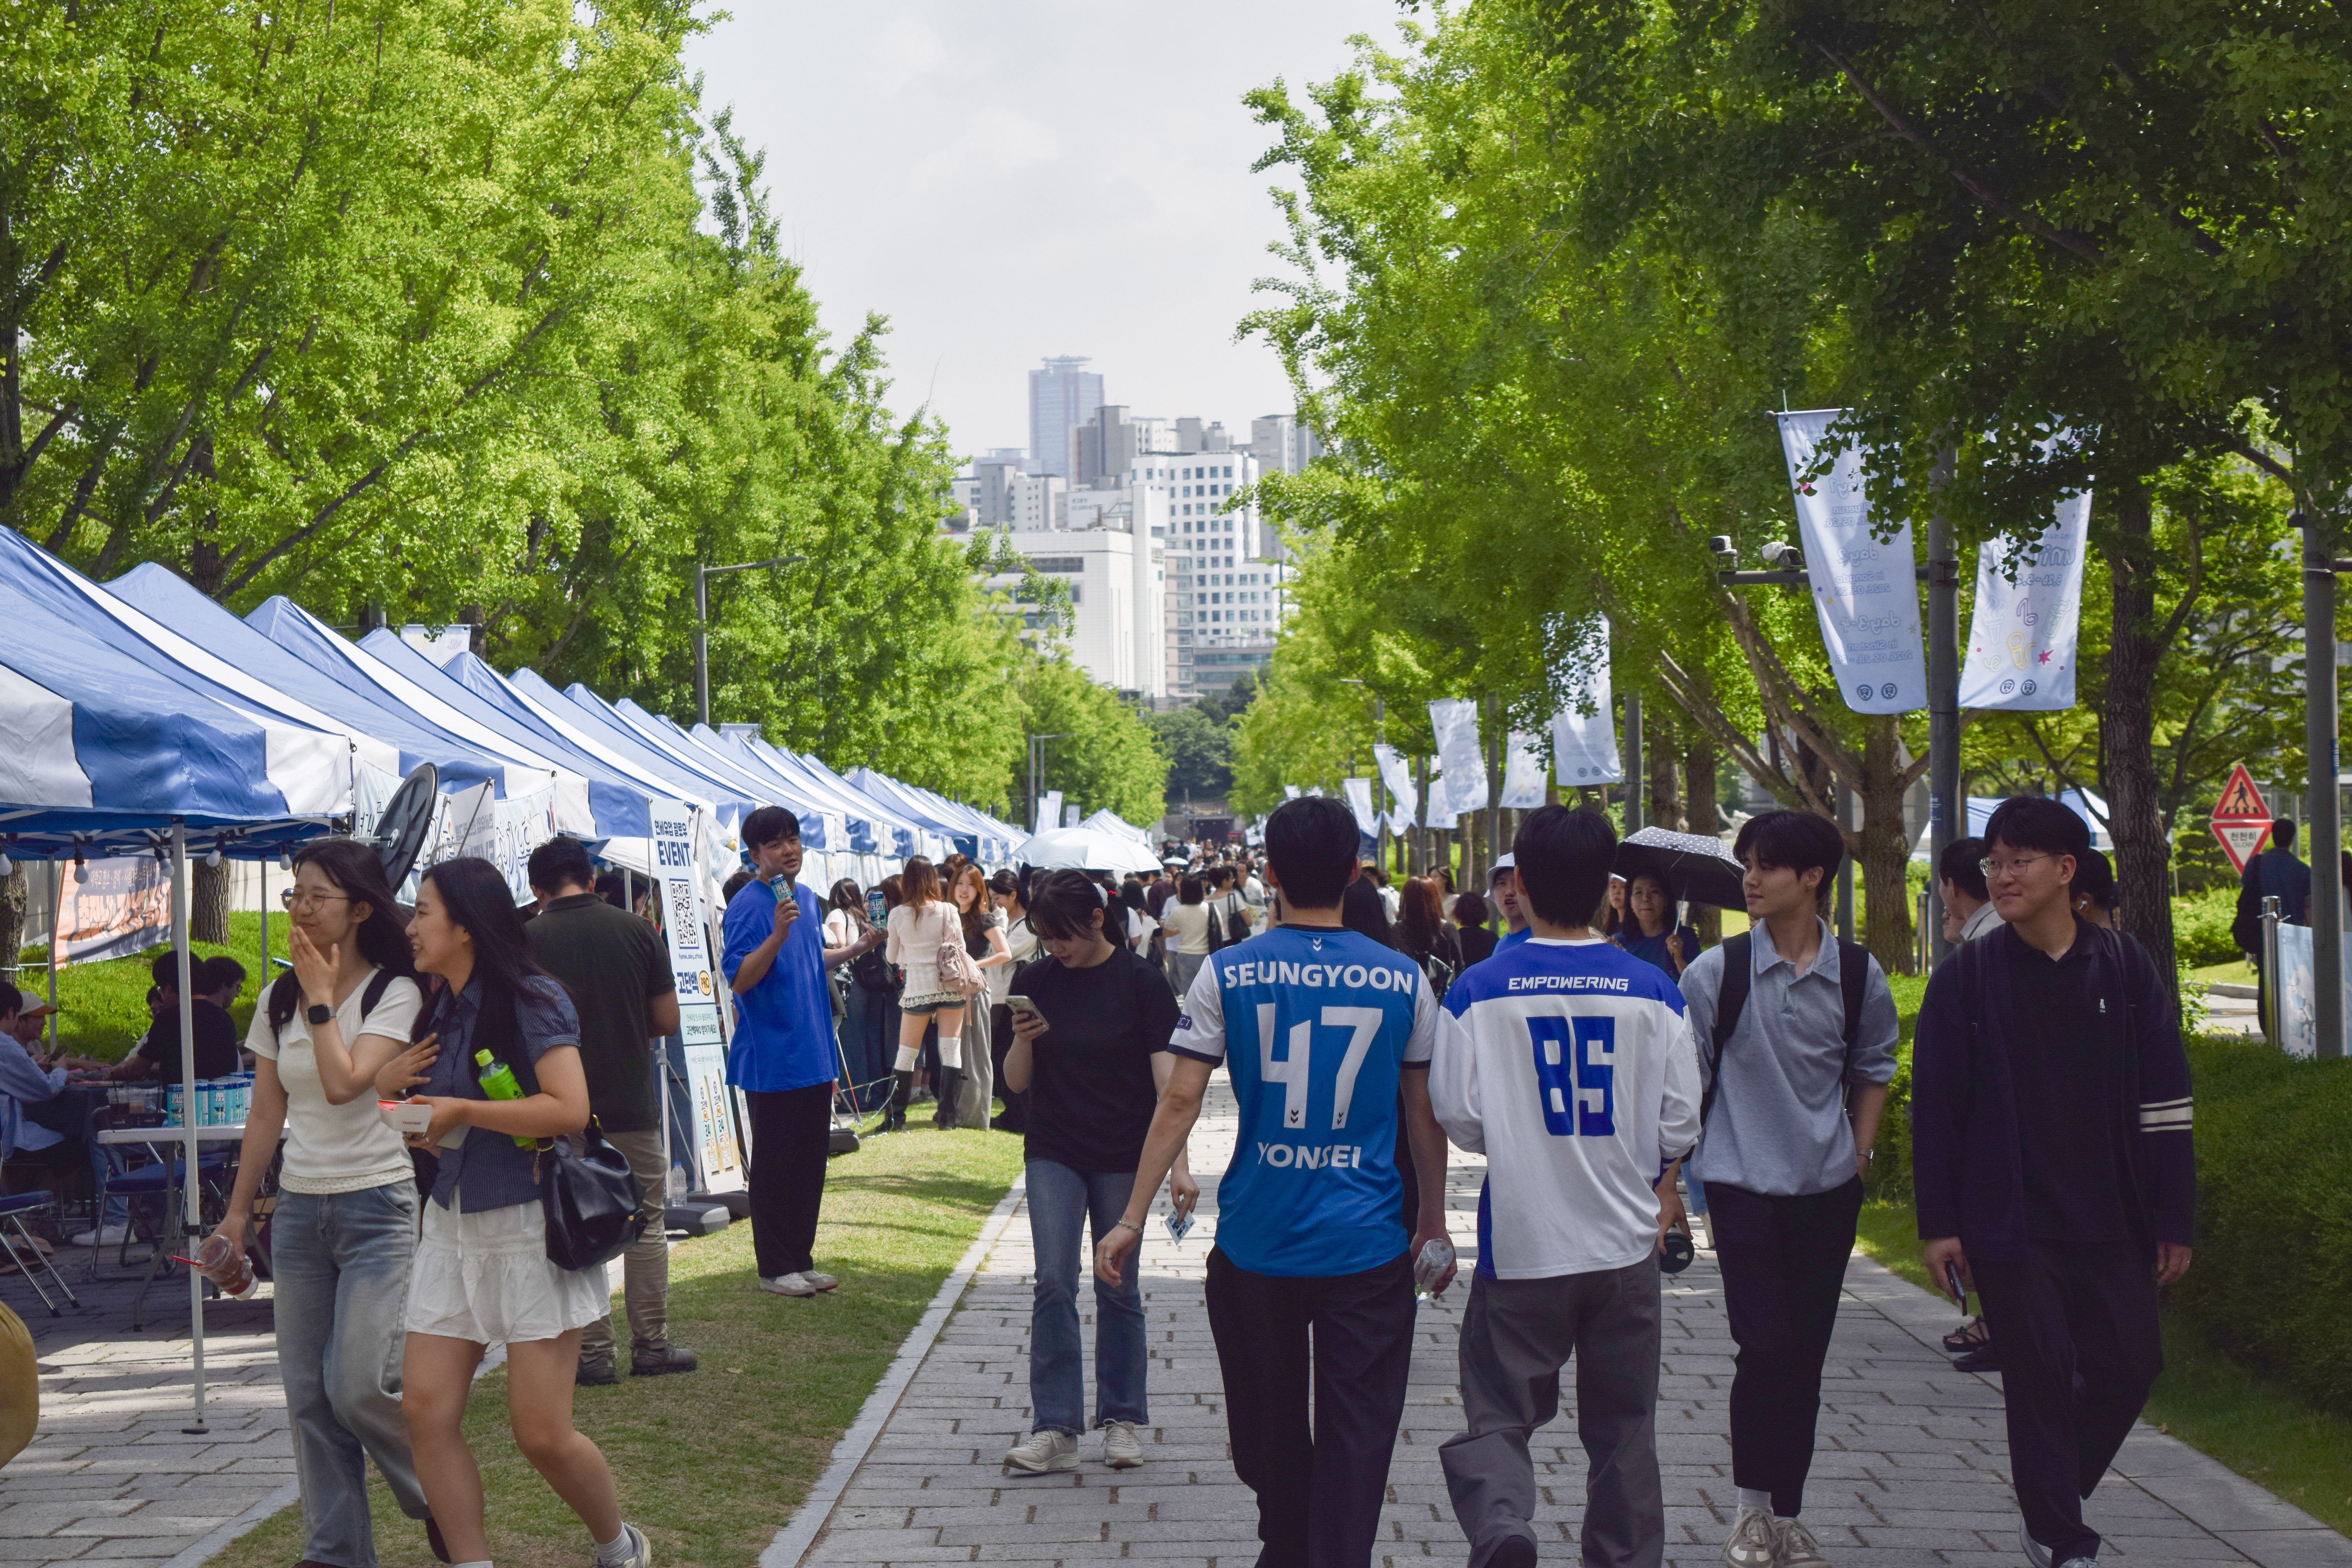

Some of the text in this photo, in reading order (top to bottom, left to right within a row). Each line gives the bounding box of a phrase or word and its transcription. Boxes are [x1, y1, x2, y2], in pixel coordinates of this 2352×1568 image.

[655, 820, 688, 837] 연세유업 팔로우
[2231, 831, 2256, 841] 천천히
[657, 840, 691, 867] EVENT
[776, 882, 789, 891] BLUE
[677, 971, 710, 994] 고단백 PRO
[1224, 961, 1413, 995] SEUNGYOON
[1508, 976, 1629, 992] EMPOWERING
[1256, 1002, 1383, 1130] 47
[1526, 1016, 1615, 1136] 85
[705, 1124, 711, 1137] 24
[718, 1118, 724, 1132] 24
[1257, 1142, 1361, 1170] YONSEI
